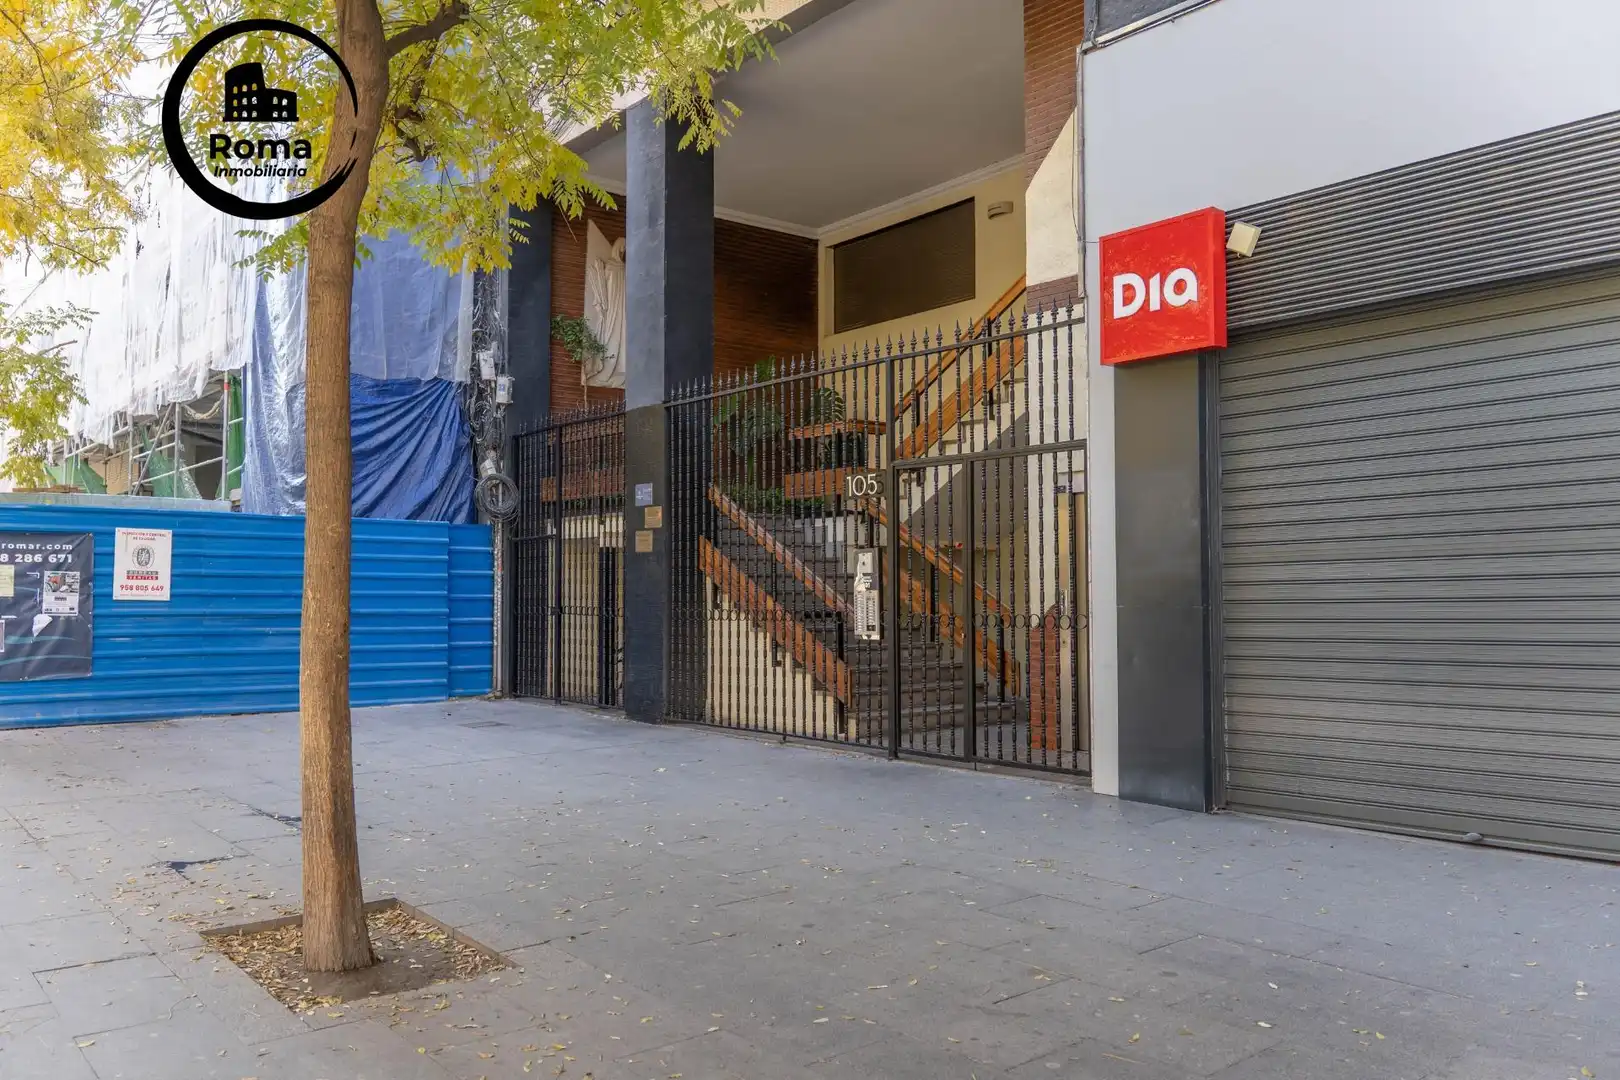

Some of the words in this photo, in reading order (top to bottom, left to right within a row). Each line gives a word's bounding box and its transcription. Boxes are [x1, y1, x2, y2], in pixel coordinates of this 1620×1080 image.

[846, 473, 878, 497] 105
[14, 554, 43, 563] 286
[48, 554, 73, 563] 671
